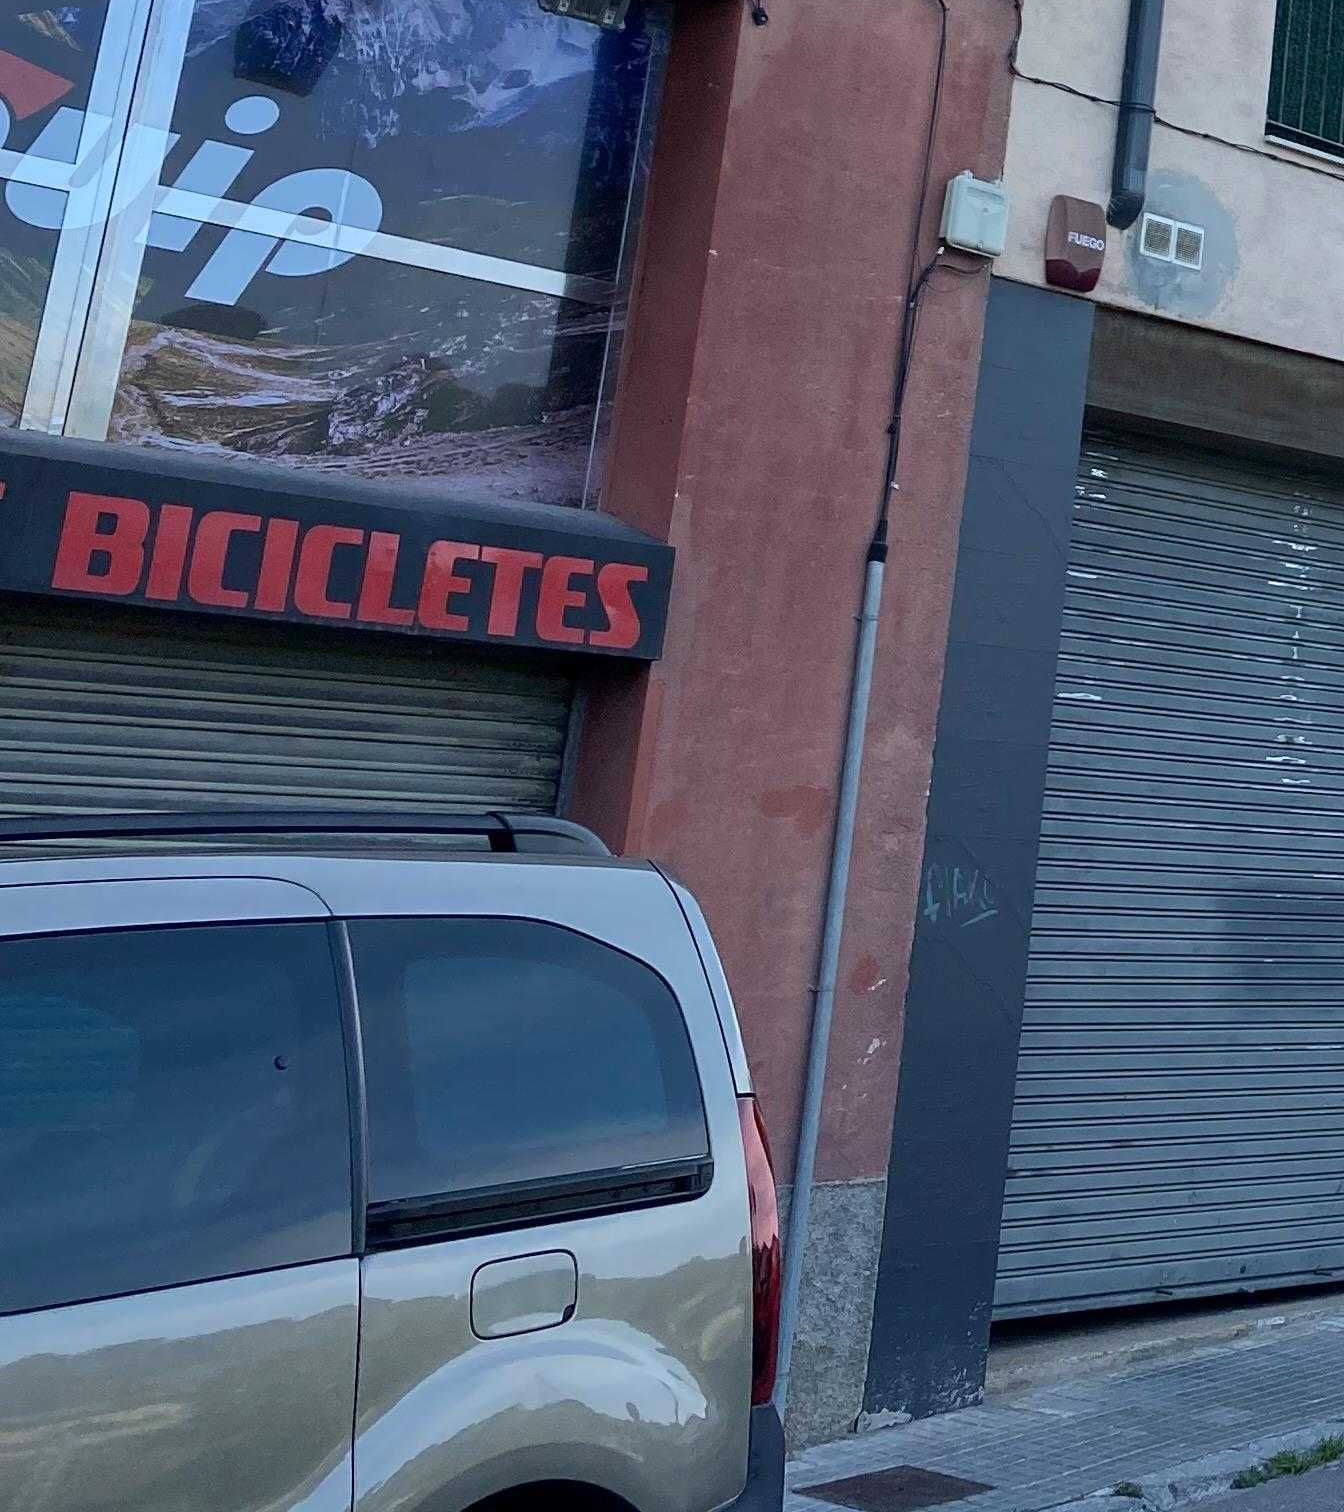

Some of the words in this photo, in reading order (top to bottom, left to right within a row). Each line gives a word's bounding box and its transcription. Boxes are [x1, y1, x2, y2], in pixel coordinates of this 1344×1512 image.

[0, 93, 382, 306] uip
[1067, 231, 1105, 251] FUEGO
[51, 491, 649, 651] BICICLETES
